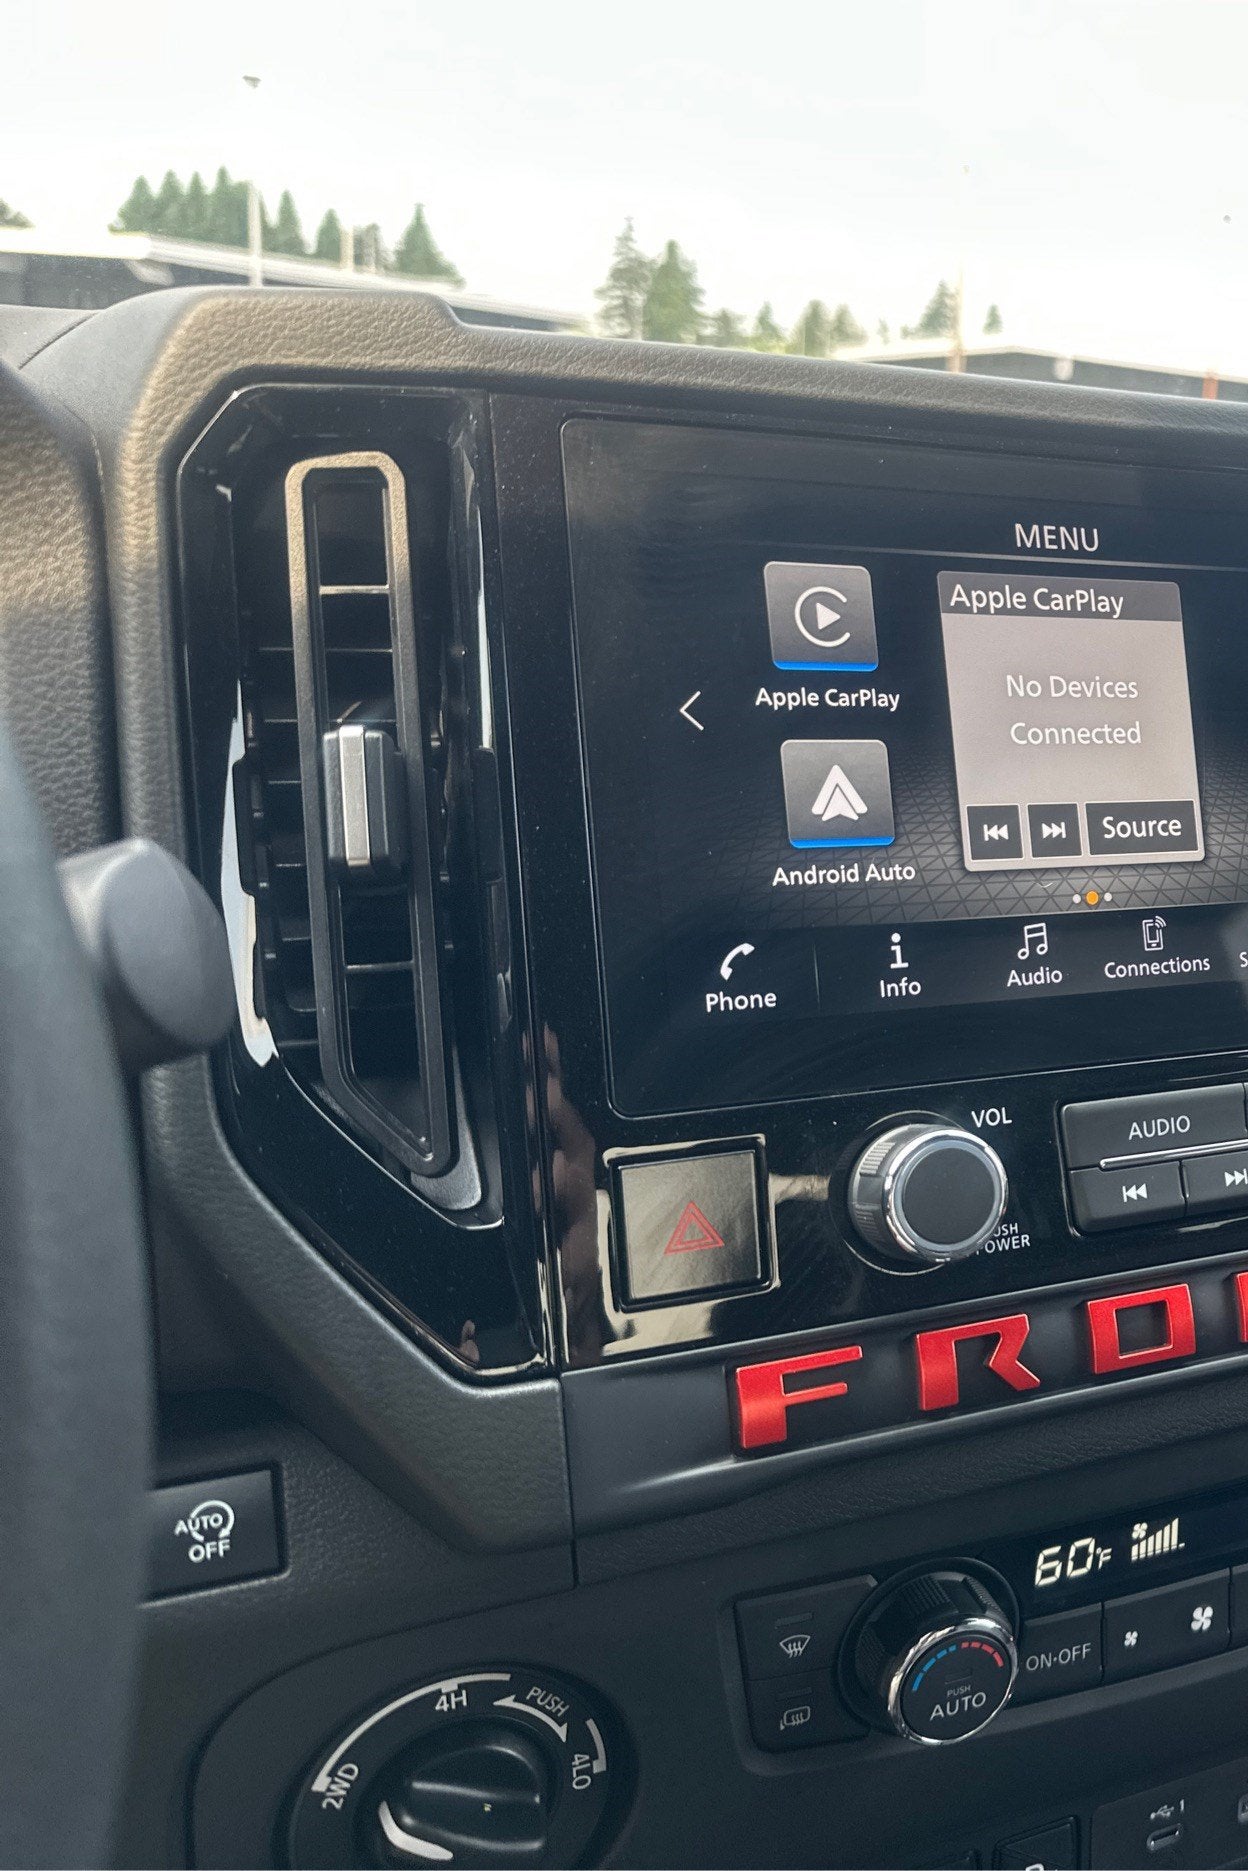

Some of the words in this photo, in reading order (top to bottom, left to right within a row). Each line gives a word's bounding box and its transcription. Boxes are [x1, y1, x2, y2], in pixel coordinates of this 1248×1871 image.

[1014, 523, 1100, 552] MENU
[949, 584, 1027, 615] Apple
[1033, 587, 1124, 618] CarPlay
[1006, 674, 1042, 698] No
[1049, 675, 1138, 699] Devices
[755, 688, 819, 709] Apple
[824, 690, 900, 712] CarPlay
[1010, 722, 1141, 745] Connected
[1102, 815, 1182, 841] Source
[772, 864, 859, 887] Android
[865, 863, 916, 882] Auto
[1006, 966, 1063, 987] Audio
[1104, 955, 1211, 980] Connections
[879, 978, 922, 998] Info
[705, 990, 777, 1012] Phone
[971, 1107, 1013, 1127] VOL
[1128, 1115, 1191, 1139] AUDIO
[992, 1222, 1019, 1237] USH
[975, 1234, 1031, 1256] OWER
[175, 1512, 223, 1536] AUTO
[189, 1538, 230, 1563] OFF
[434, 1688, 468, 1713] 4H
[526, 1685, 570, 1718] PUSH
[946, 1684, 971, 1698] PUSH
[929, 1691, 987, 1721] AUTO
[569, 1751, 592, 1791] 4LO
[320, 1761, 360, 1811] 2WD
[1179, 1799, 1186, 1813] 1
